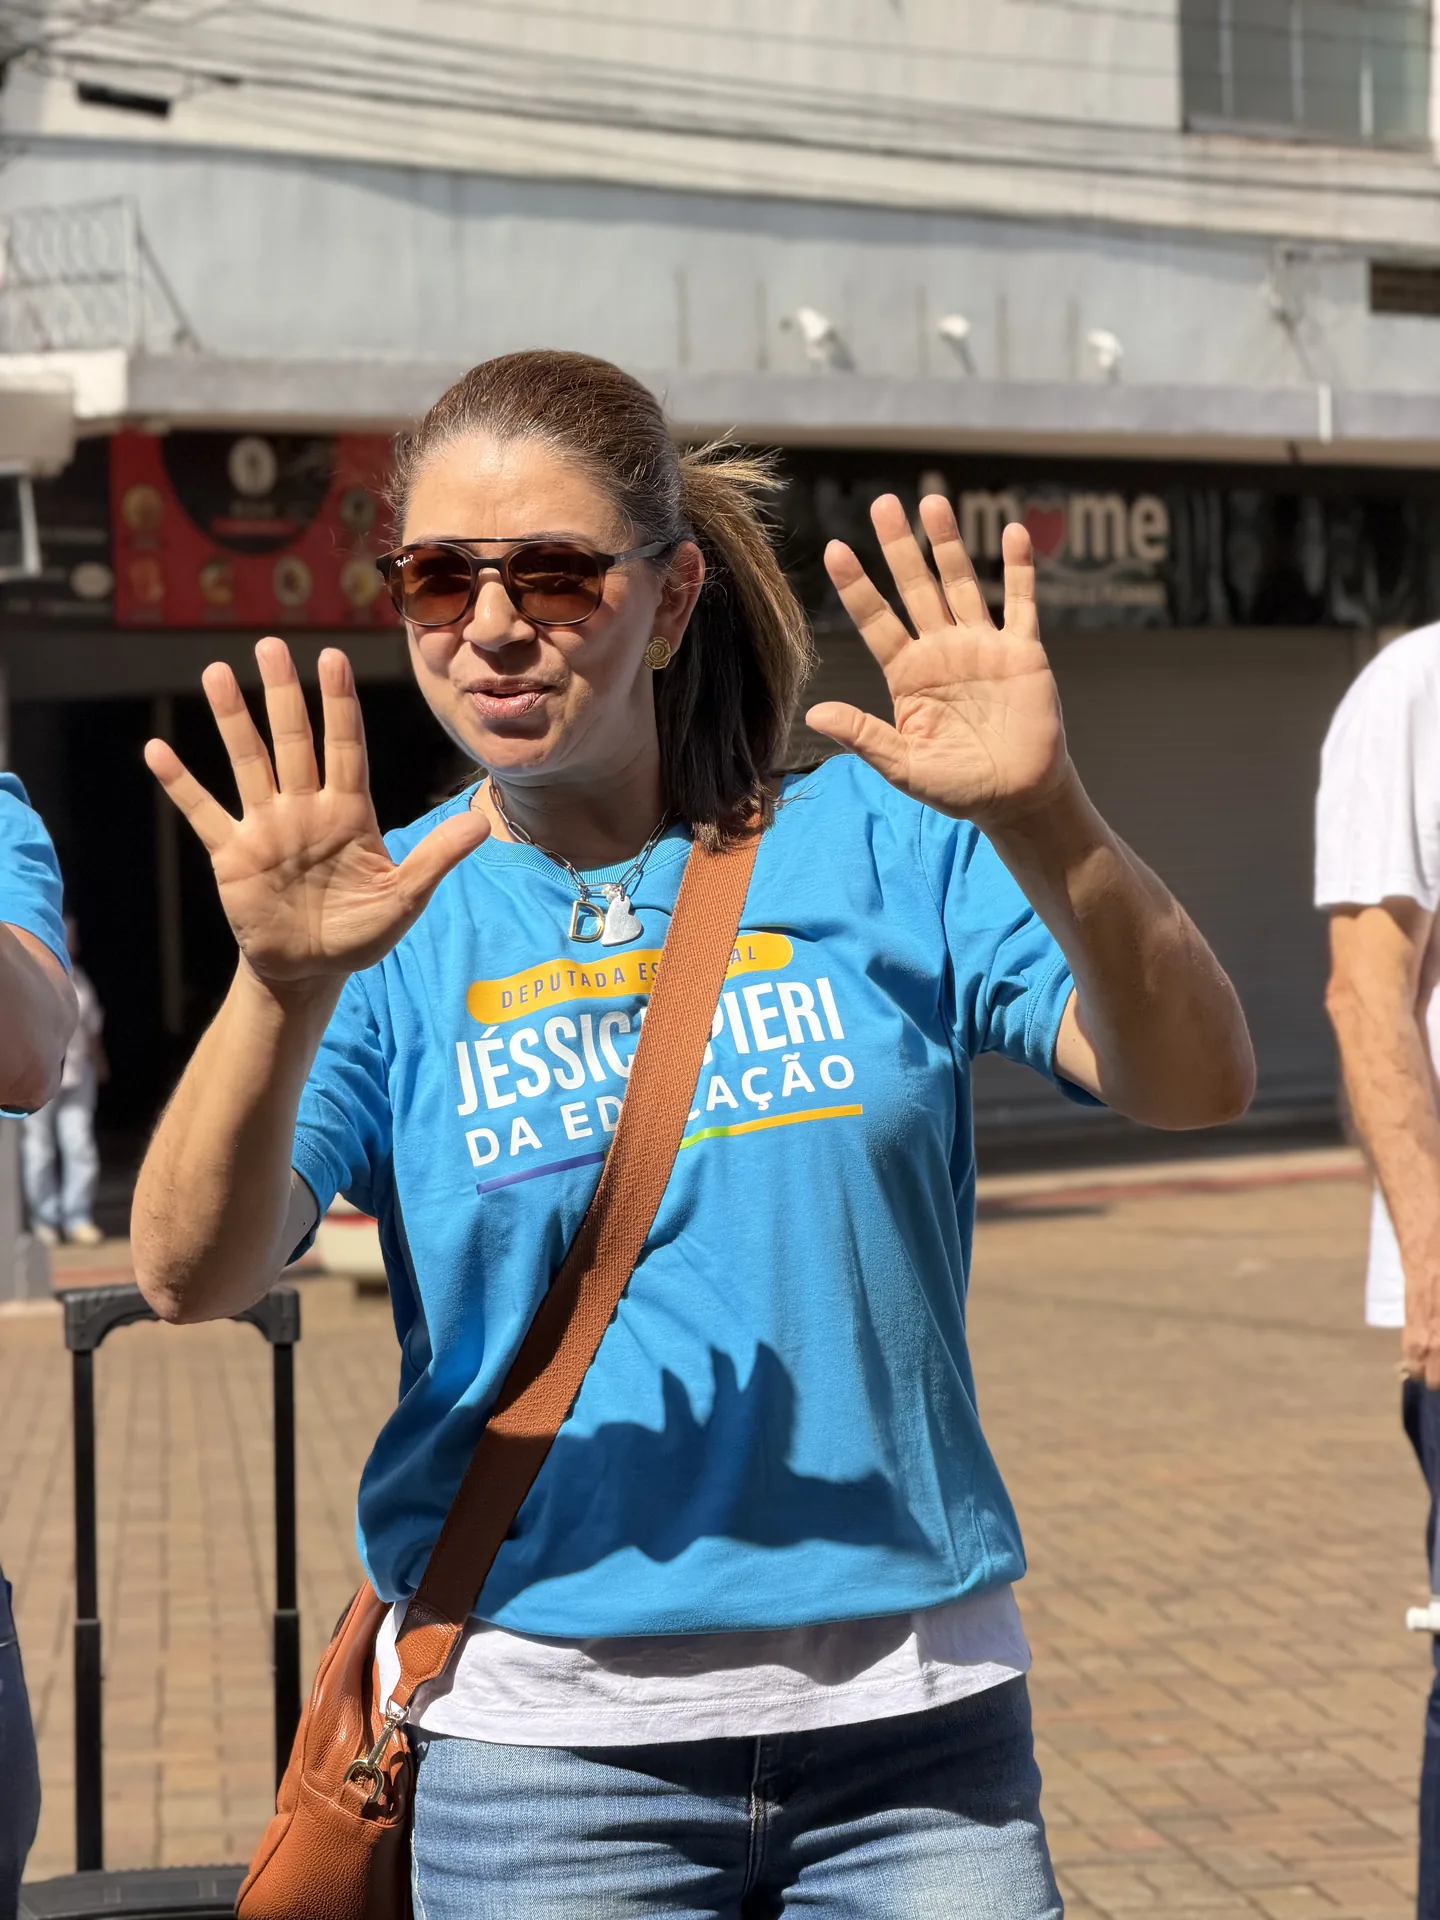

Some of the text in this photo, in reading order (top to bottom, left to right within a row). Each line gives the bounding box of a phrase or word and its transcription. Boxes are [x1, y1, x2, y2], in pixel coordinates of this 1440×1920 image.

[501, 946, 757, 1009] DEPUTADA ESAL
[456, 1007, 649, 1116] JÉSSIC
[465, 1052, 855, 1167] DA EDAÇÃO
